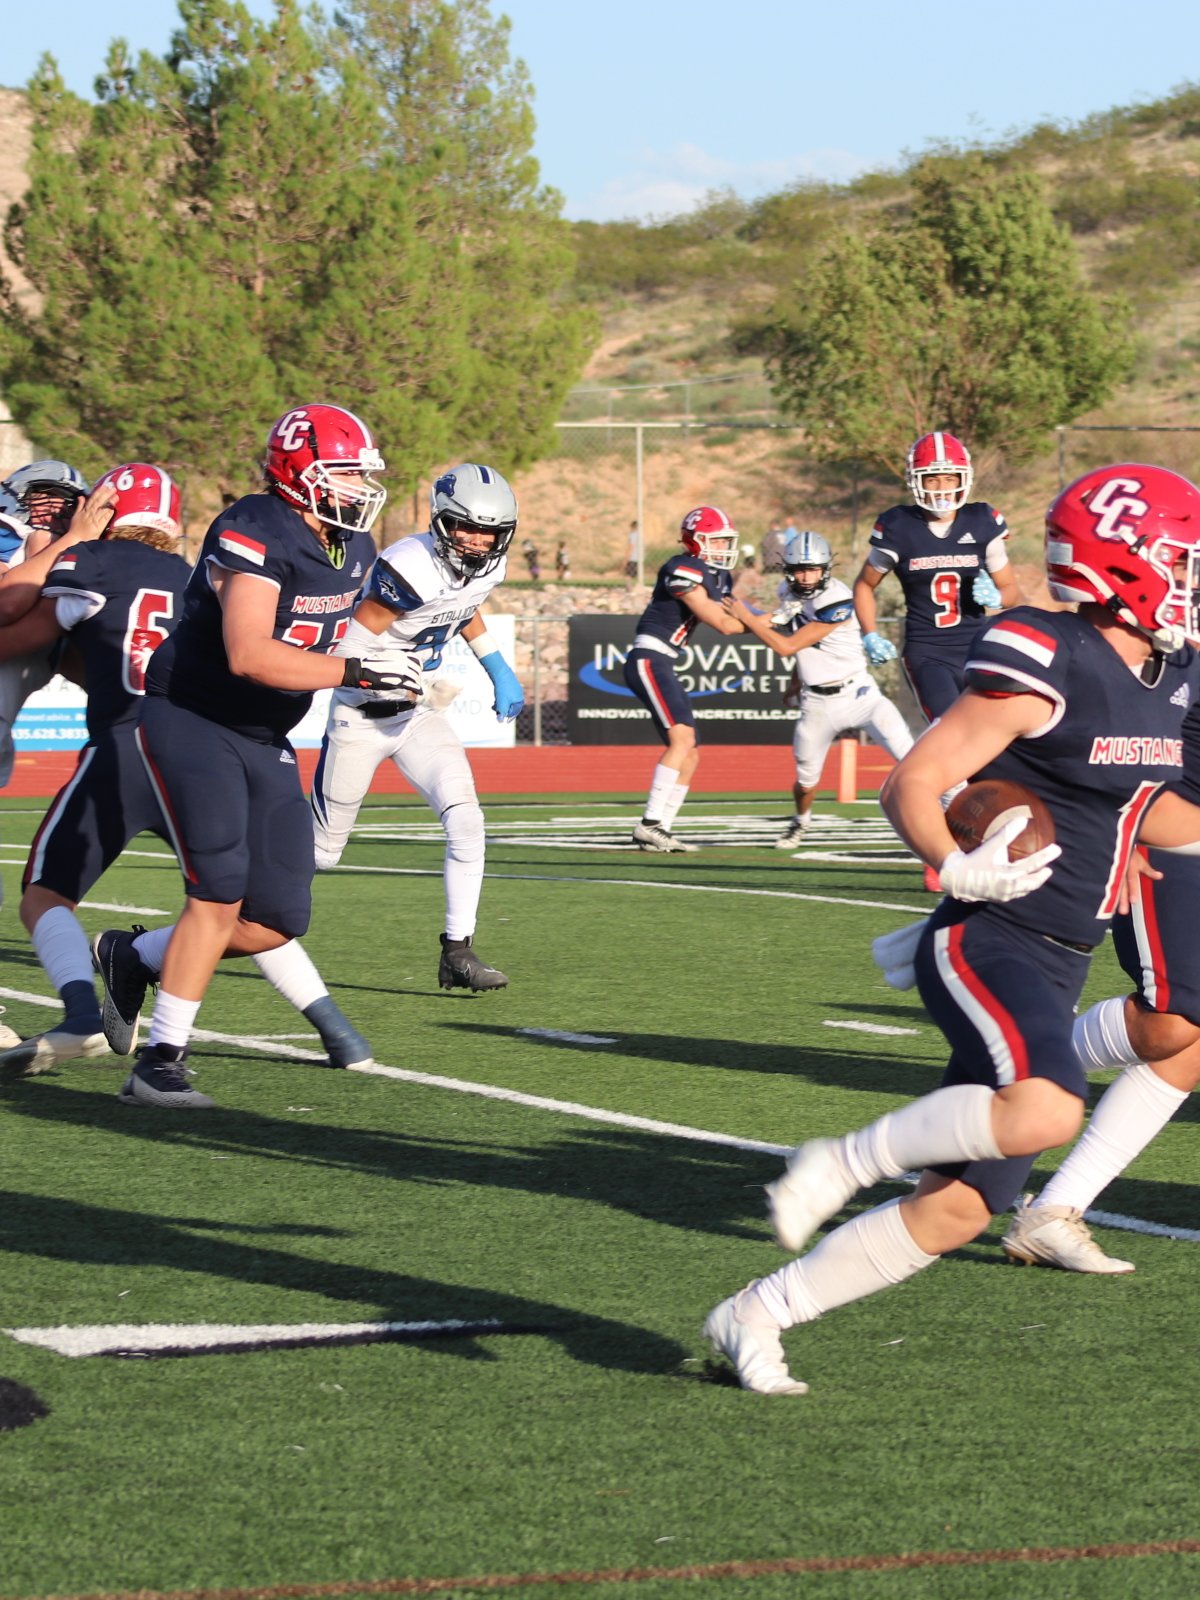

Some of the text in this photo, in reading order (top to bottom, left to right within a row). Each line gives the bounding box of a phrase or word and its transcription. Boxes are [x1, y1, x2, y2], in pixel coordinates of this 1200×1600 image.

[277, 410, 312, 451] CC
[1088, 477, 1150, 539] CC
[909, 555, 979, 571] MUSTANGS
[290, 593, 358, 614] MUSTAN
[431, 603, 480, 624] STALLIO
[930, 571, 961, 628] 9
[1088, 736, 1184, 768] MUSTANG
